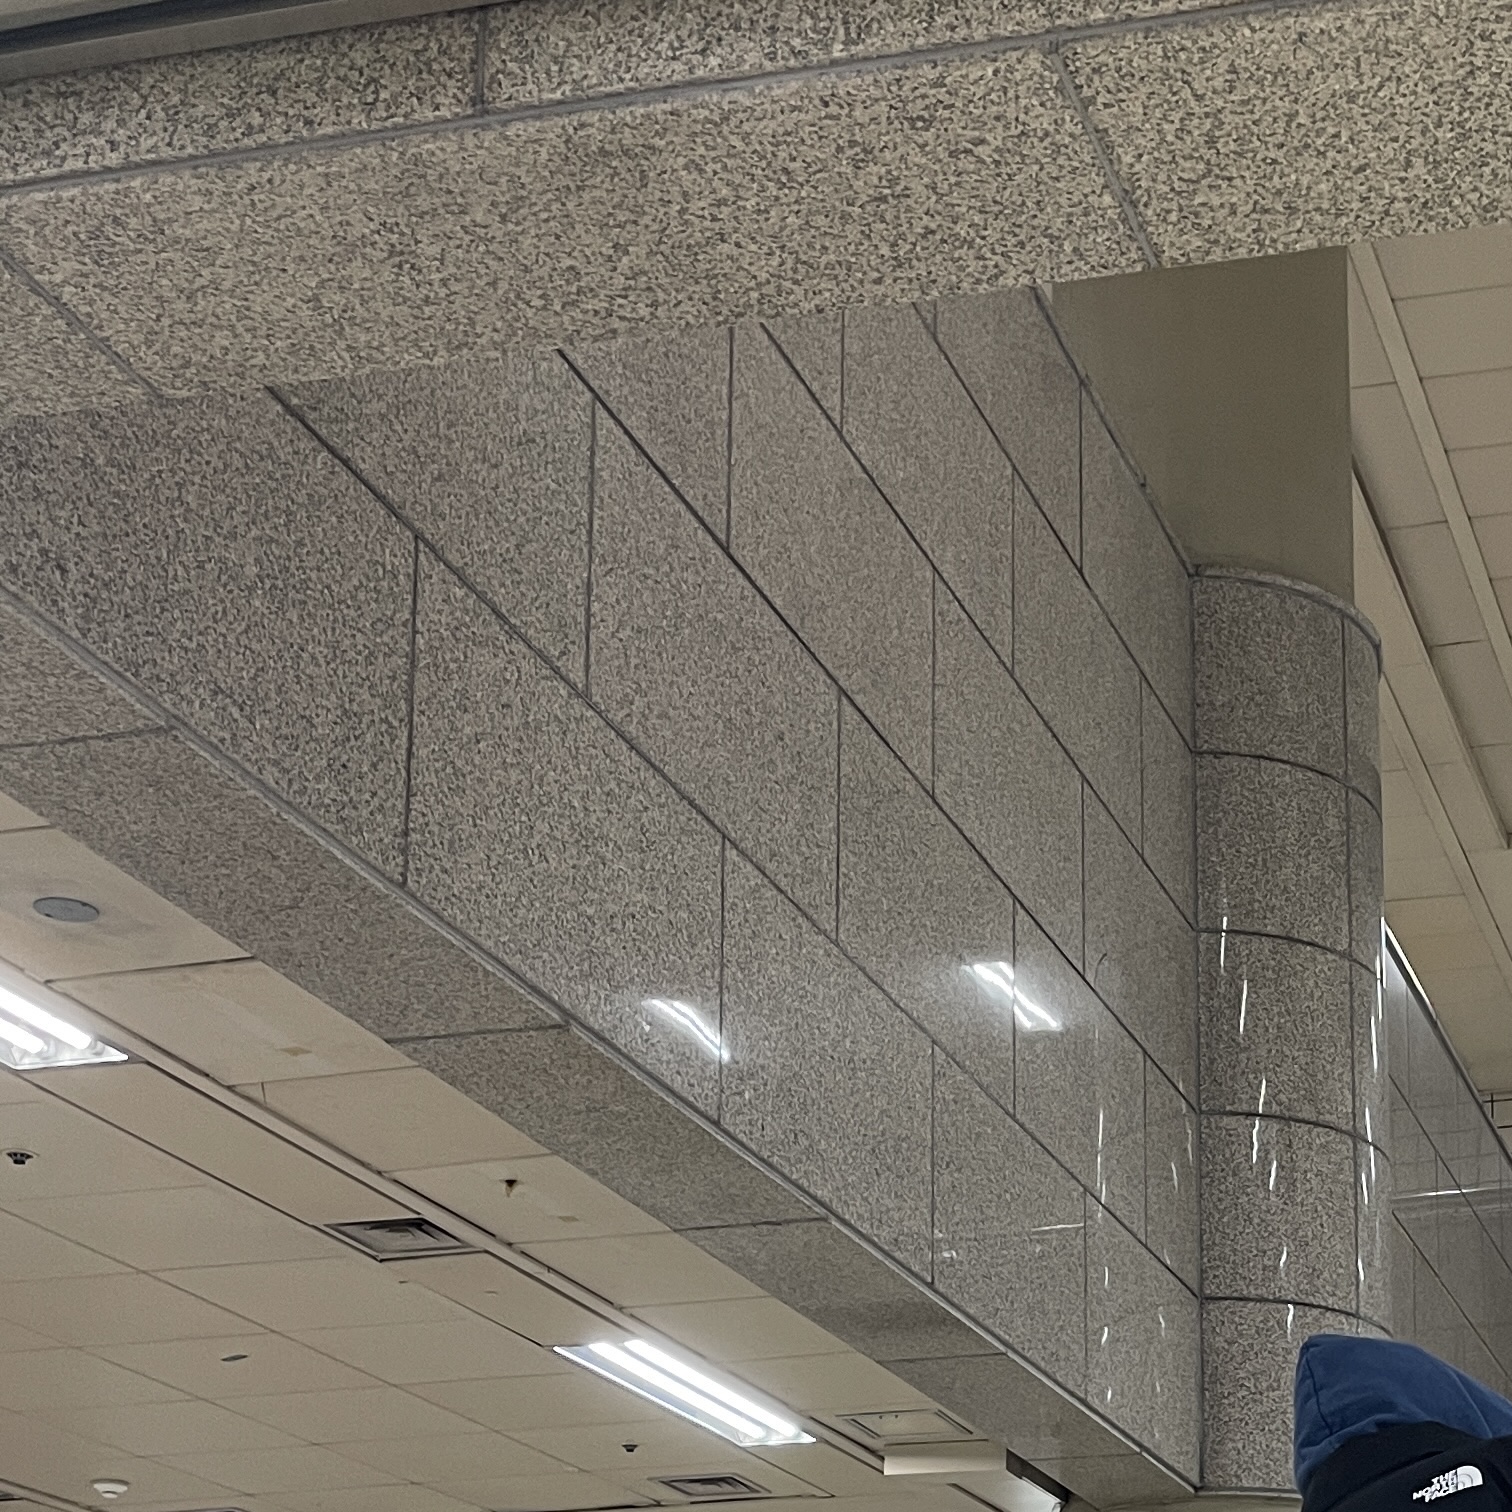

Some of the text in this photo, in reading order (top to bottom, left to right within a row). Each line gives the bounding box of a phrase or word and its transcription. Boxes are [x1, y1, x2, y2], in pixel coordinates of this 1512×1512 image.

[1431, 1469, 1457, 1484] THE
[1412, 1476, 1457, 1501] NORTH
[1424, 1485, 1457, 1503] FACE
